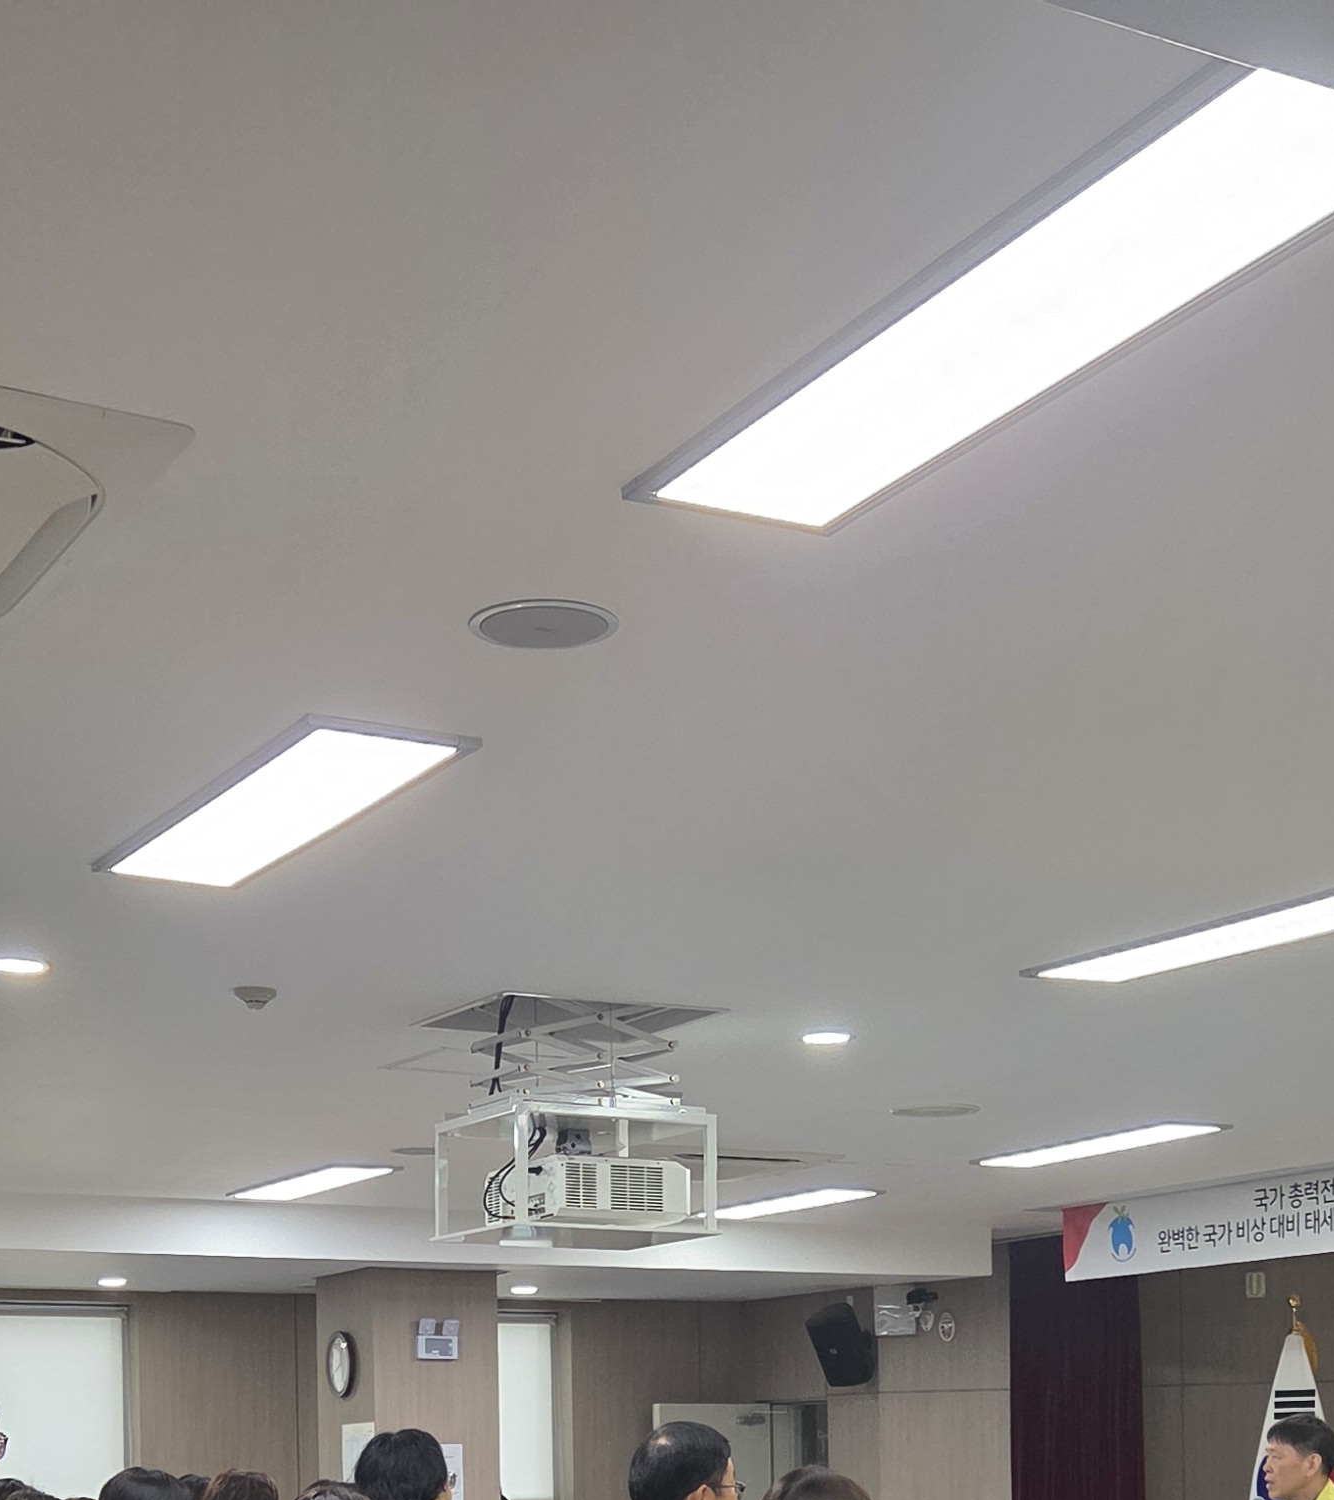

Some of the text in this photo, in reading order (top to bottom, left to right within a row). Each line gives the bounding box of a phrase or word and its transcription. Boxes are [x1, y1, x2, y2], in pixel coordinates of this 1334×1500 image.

[1254, 1186, 1284, 1212] 국가
[1157, 1225, 1199, 1254] 완벽한
[1204, 1222, 1232, 1248] 국가
[1236, 1217, 1266, 1244] 비상
[1269, 1213, 1301, 1240] 대비
